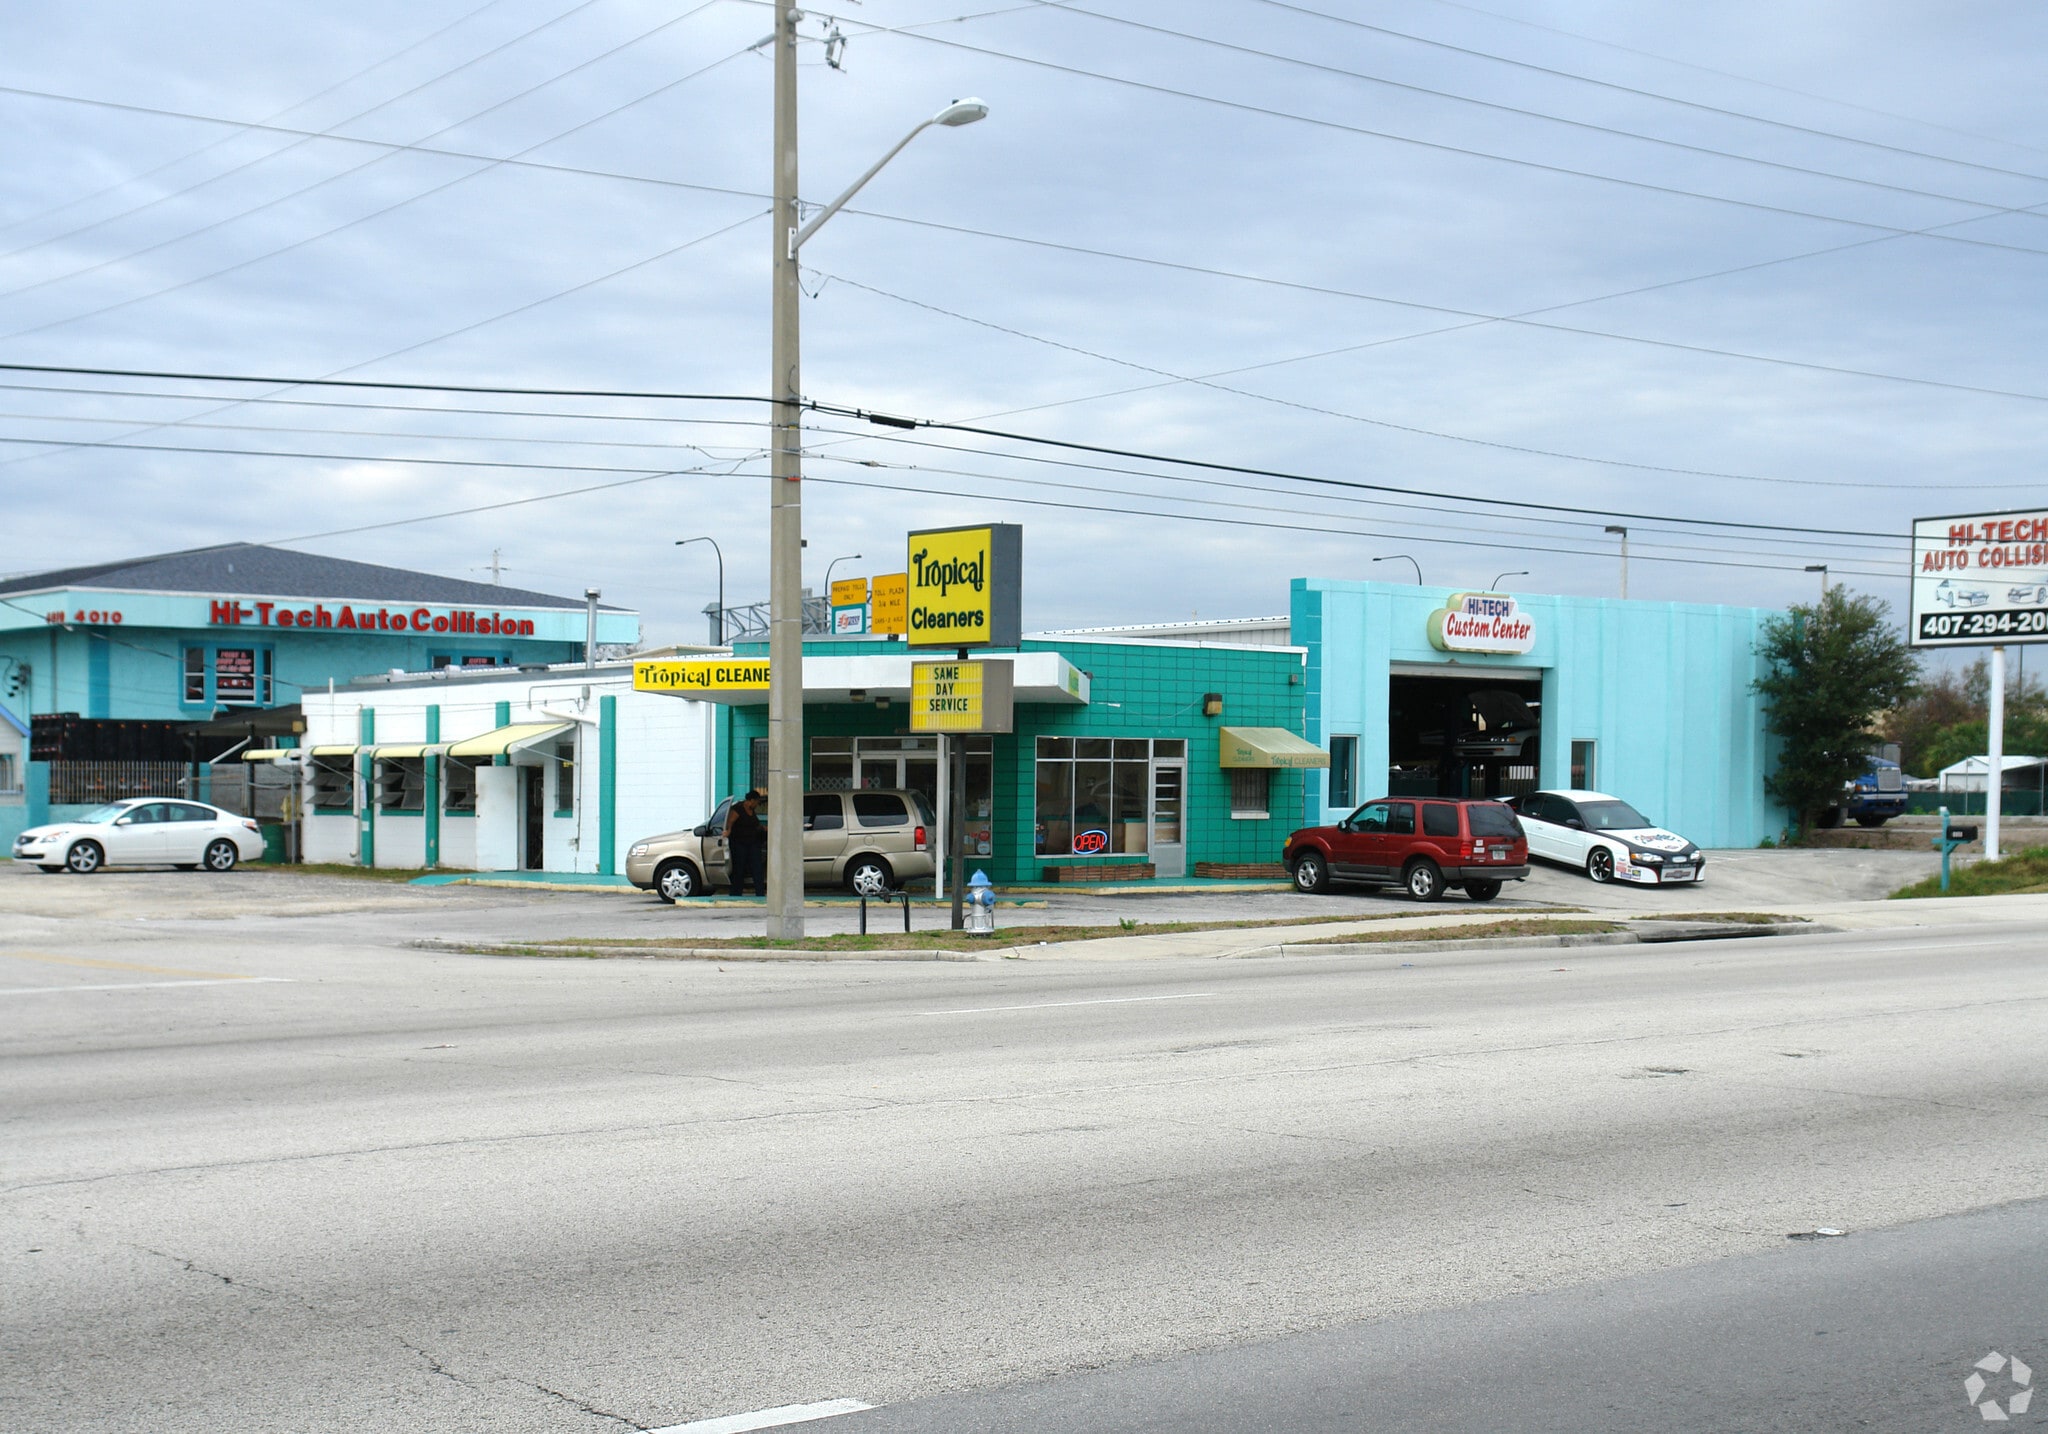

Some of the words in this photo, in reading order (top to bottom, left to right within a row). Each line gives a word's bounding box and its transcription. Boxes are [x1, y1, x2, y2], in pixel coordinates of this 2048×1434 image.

[1949, 519, 2048, 547] HI-TECH
[1922, 550, 1969, 572] AUTO
[913, 548, 984, 597] Tropical
[75, 610, 122, 623] 4010
[211, 601, 332, 628] Hi-Tech
[337, 606, 407, 631] Auto
[411, 608, 534, 635] Collision
[912, 607, 984, 630] Cleaners
[1468, 598, 1509, 617] HI-TECH
[1447, 613, 1490, 638] Custom
[1493, 616, 1531, 640] Center
[1924, 612, 2048, 635] 407-294-20
[639, 665, 711, 687] Tropical
[934, 667, 959, 680] SAME
[936, 683, 954, 695] DAY
[930, 698, 968, 712] SERVICE
[1074, 835, 1104, 850] OPEN
